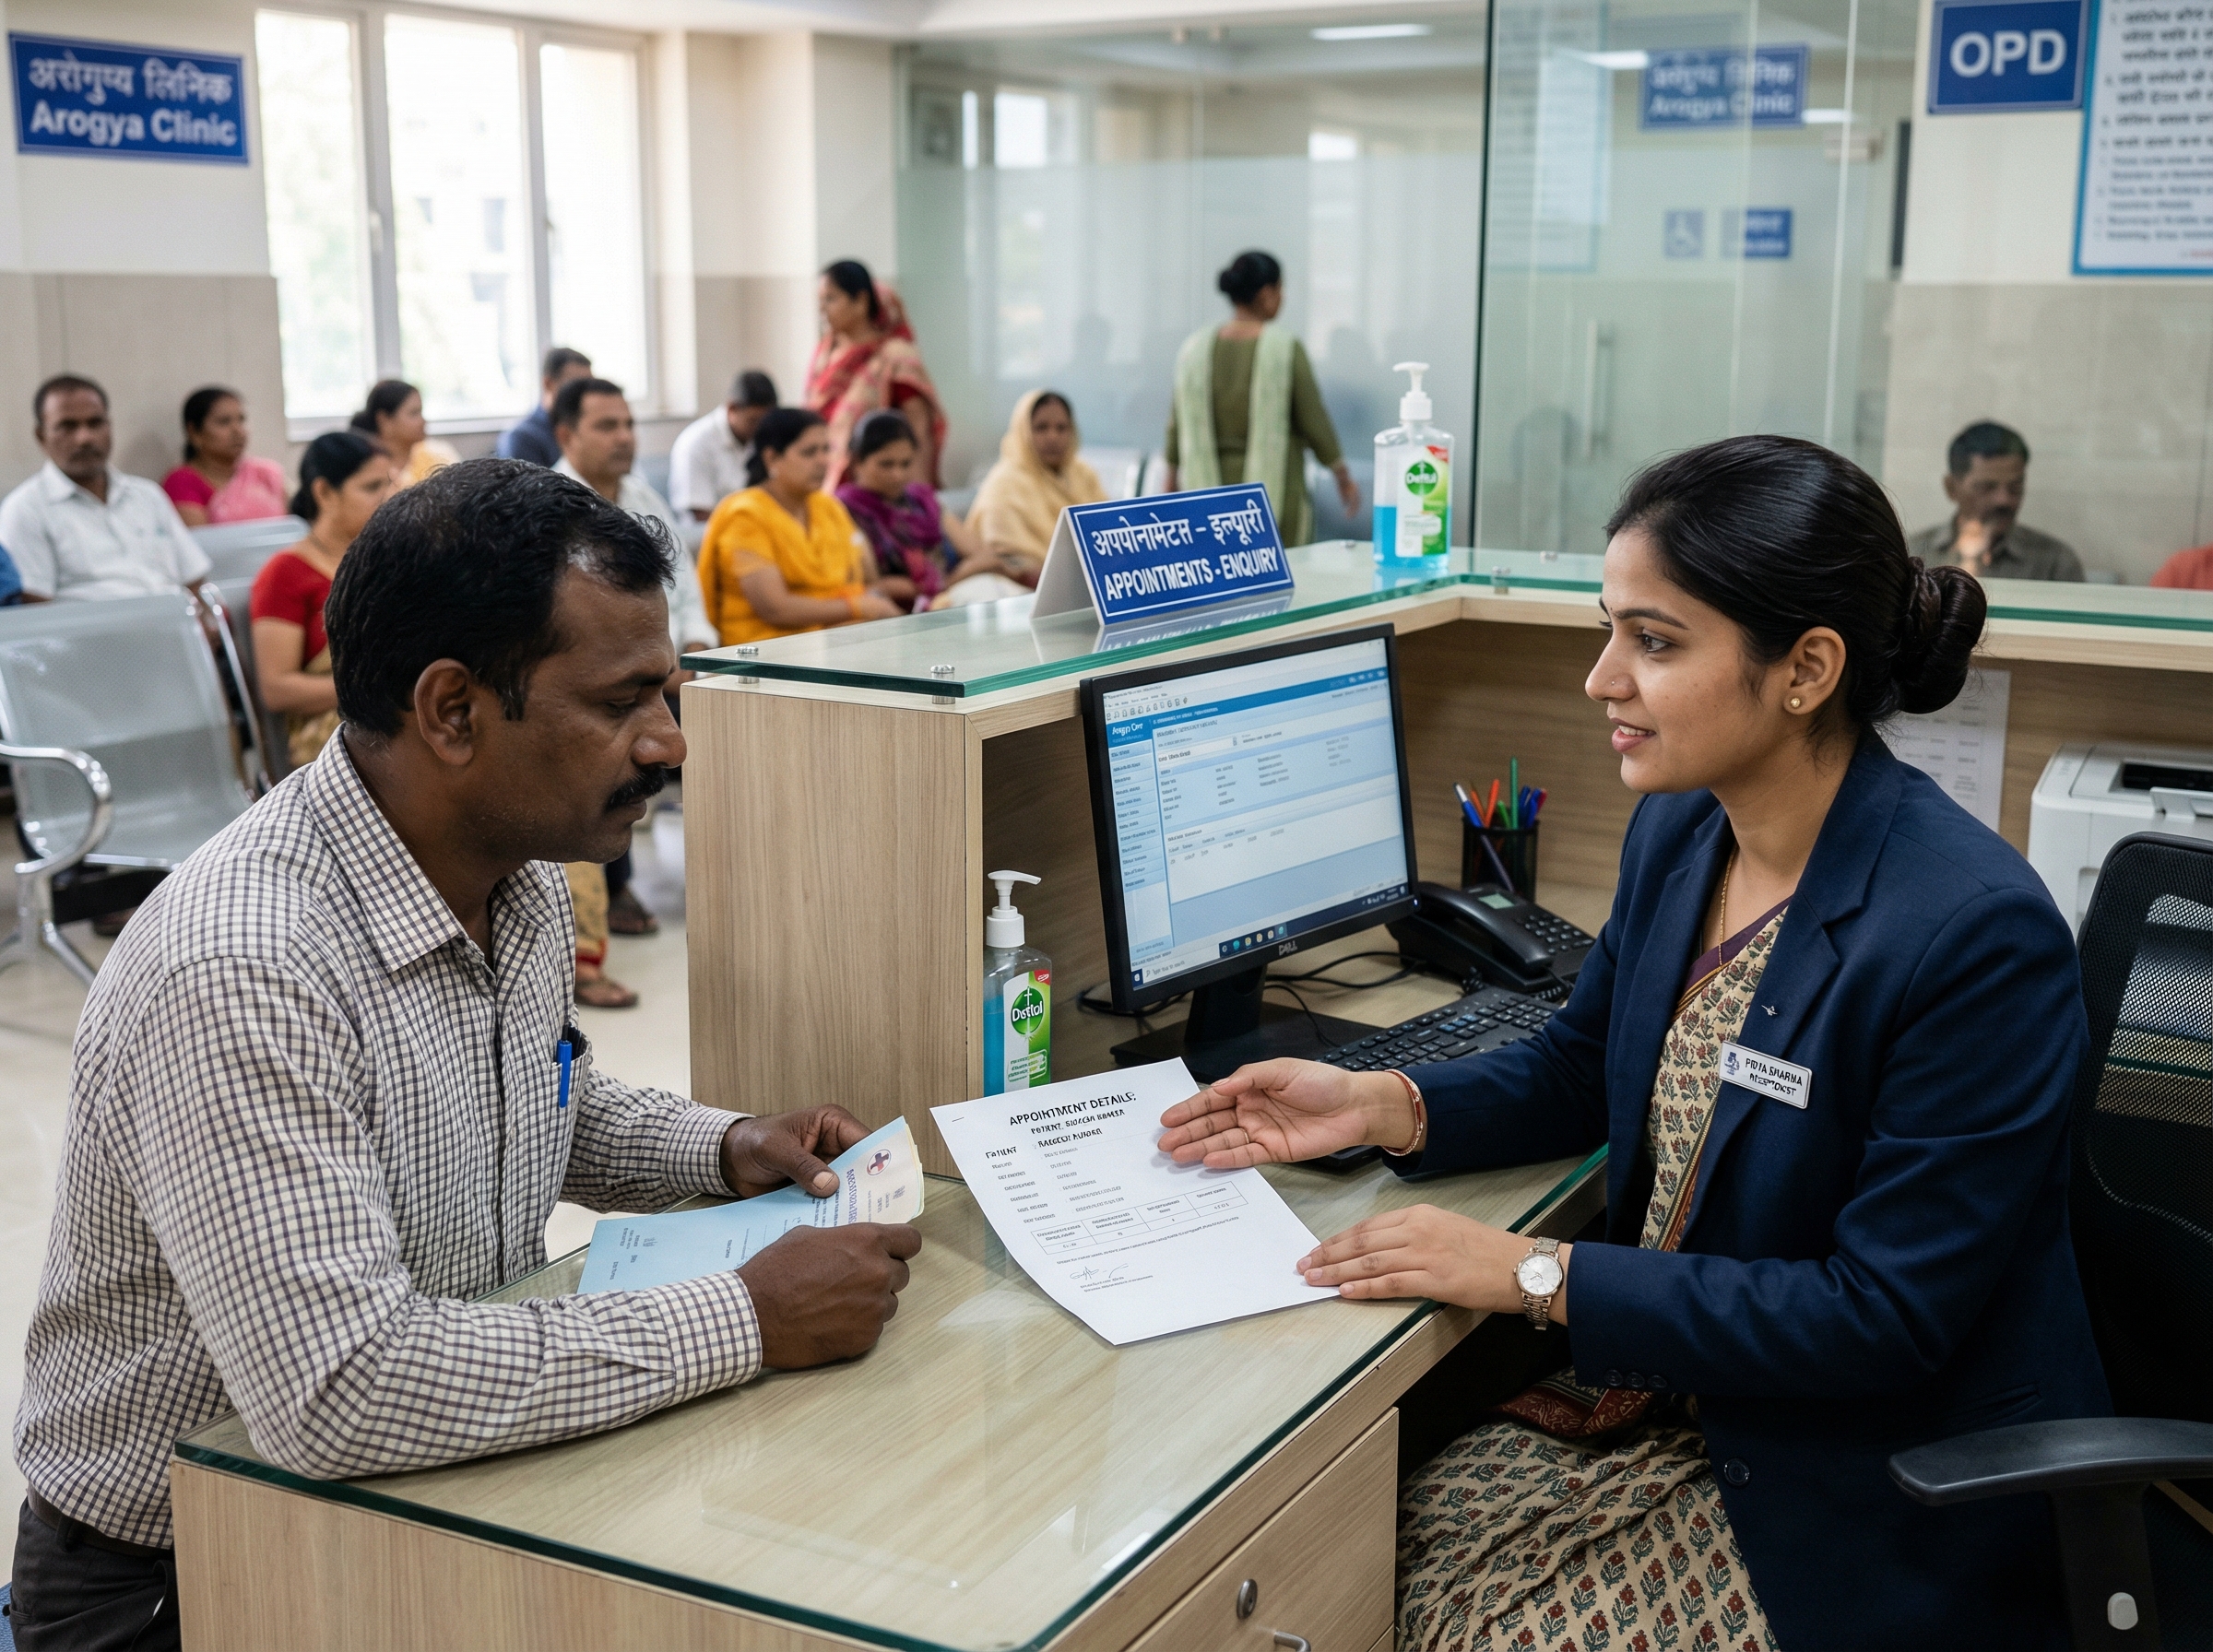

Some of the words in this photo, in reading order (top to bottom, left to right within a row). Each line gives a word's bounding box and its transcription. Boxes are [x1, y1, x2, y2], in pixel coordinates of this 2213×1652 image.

[1949, 29, 2067, 77] OPD
[30, 100, 145, 147] Arogya
[150, 108, 237, 147] Clinic
[1105, 559, 1213, 601] APPOINTMENTS
[1220, 548, 1279, 580] ENQUIRY
